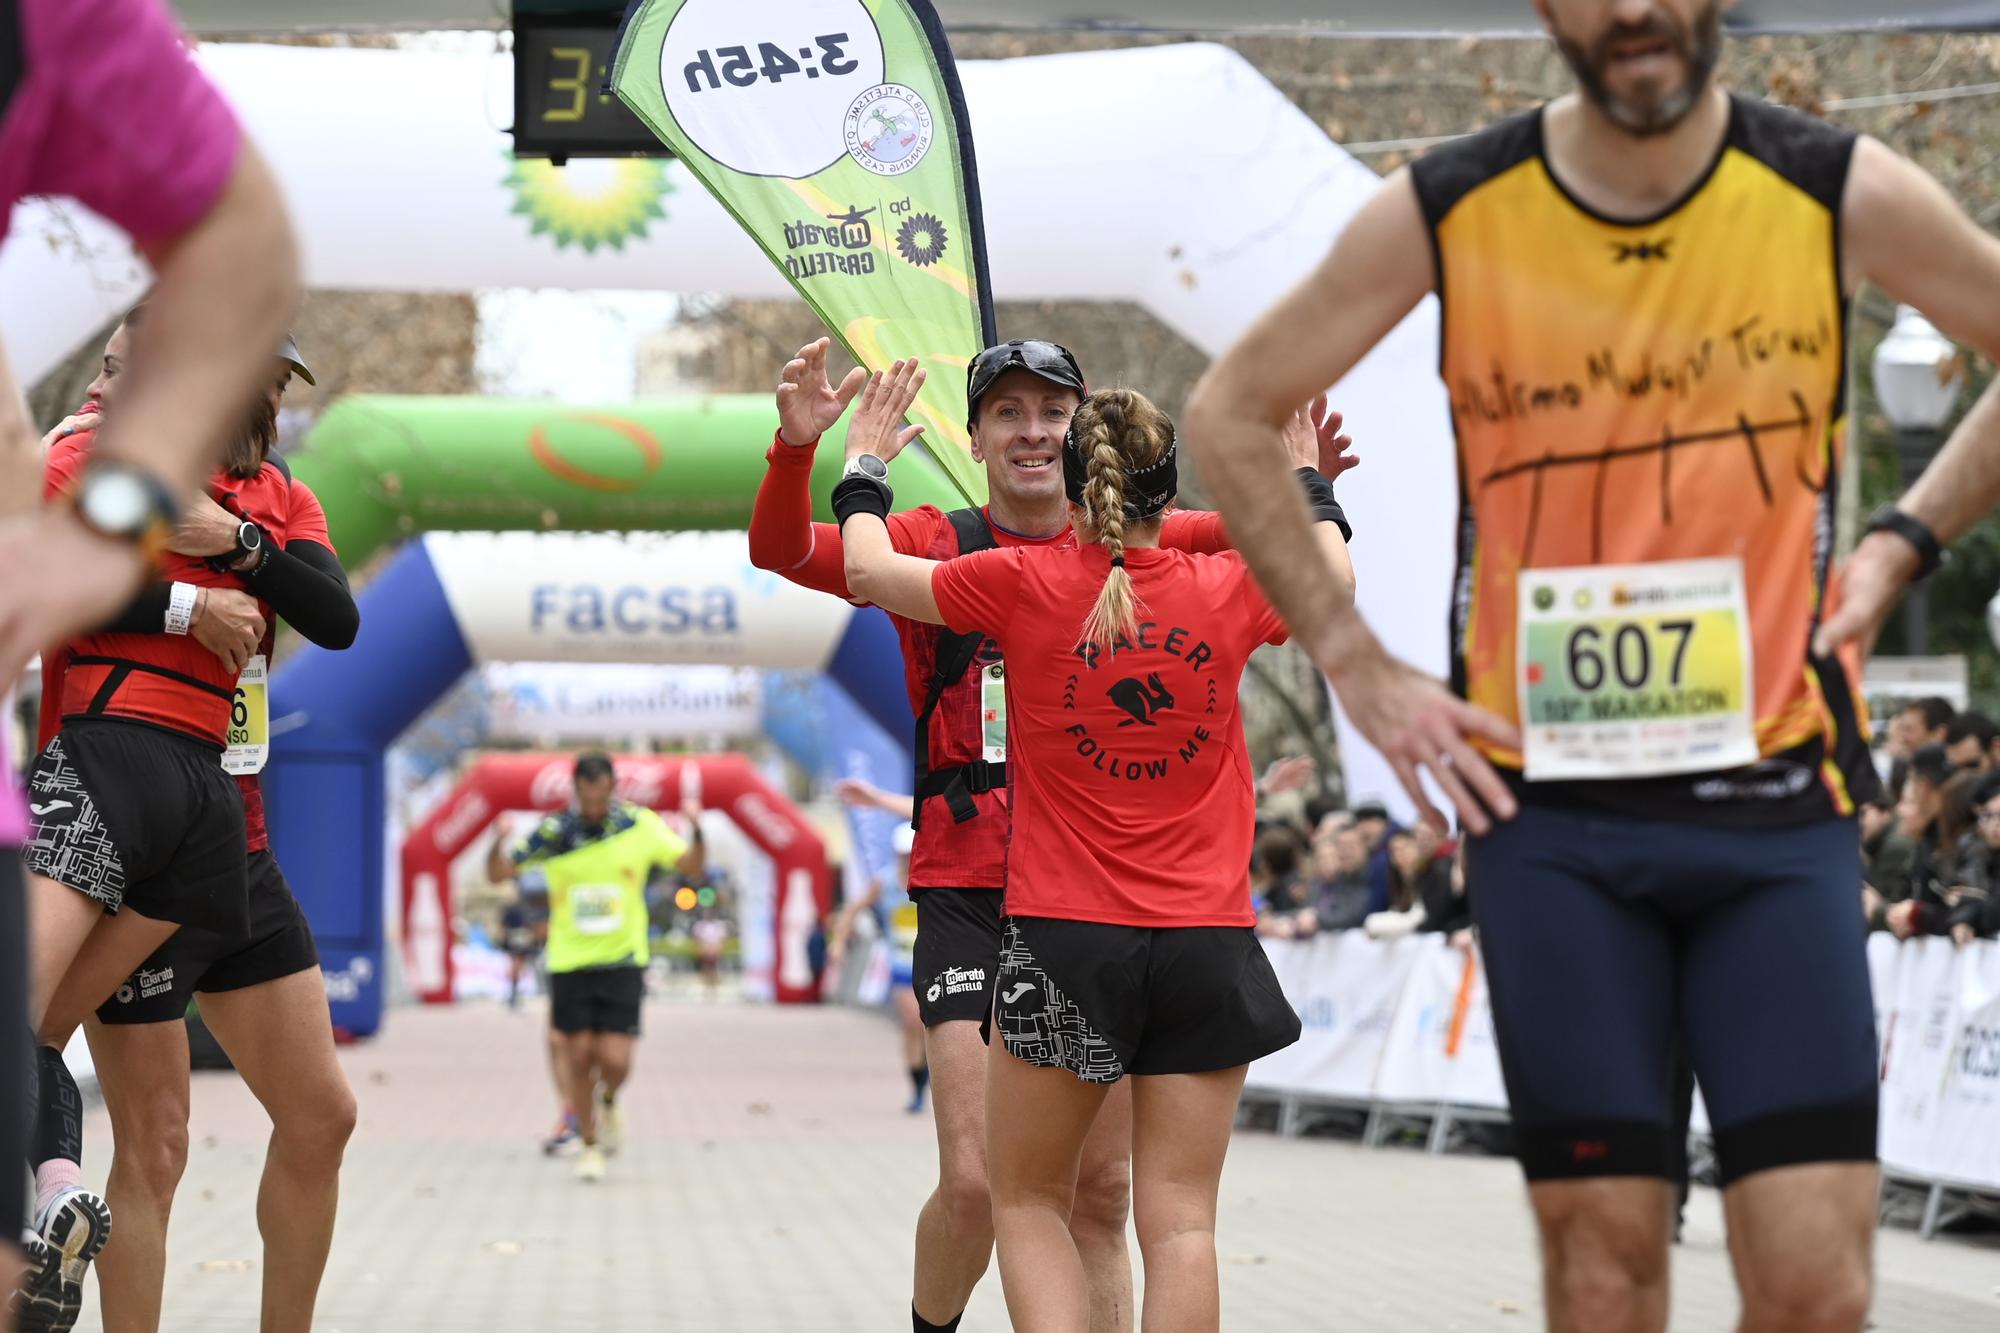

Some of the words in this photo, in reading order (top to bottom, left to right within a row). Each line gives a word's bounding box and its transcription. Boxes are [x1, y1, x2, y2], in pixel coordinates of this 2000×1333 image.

[1567, 619, 1696, 692] 607
[1065, 723, 1168, 781] FOLLOW
[1179, 725, 1211, 764] ME
